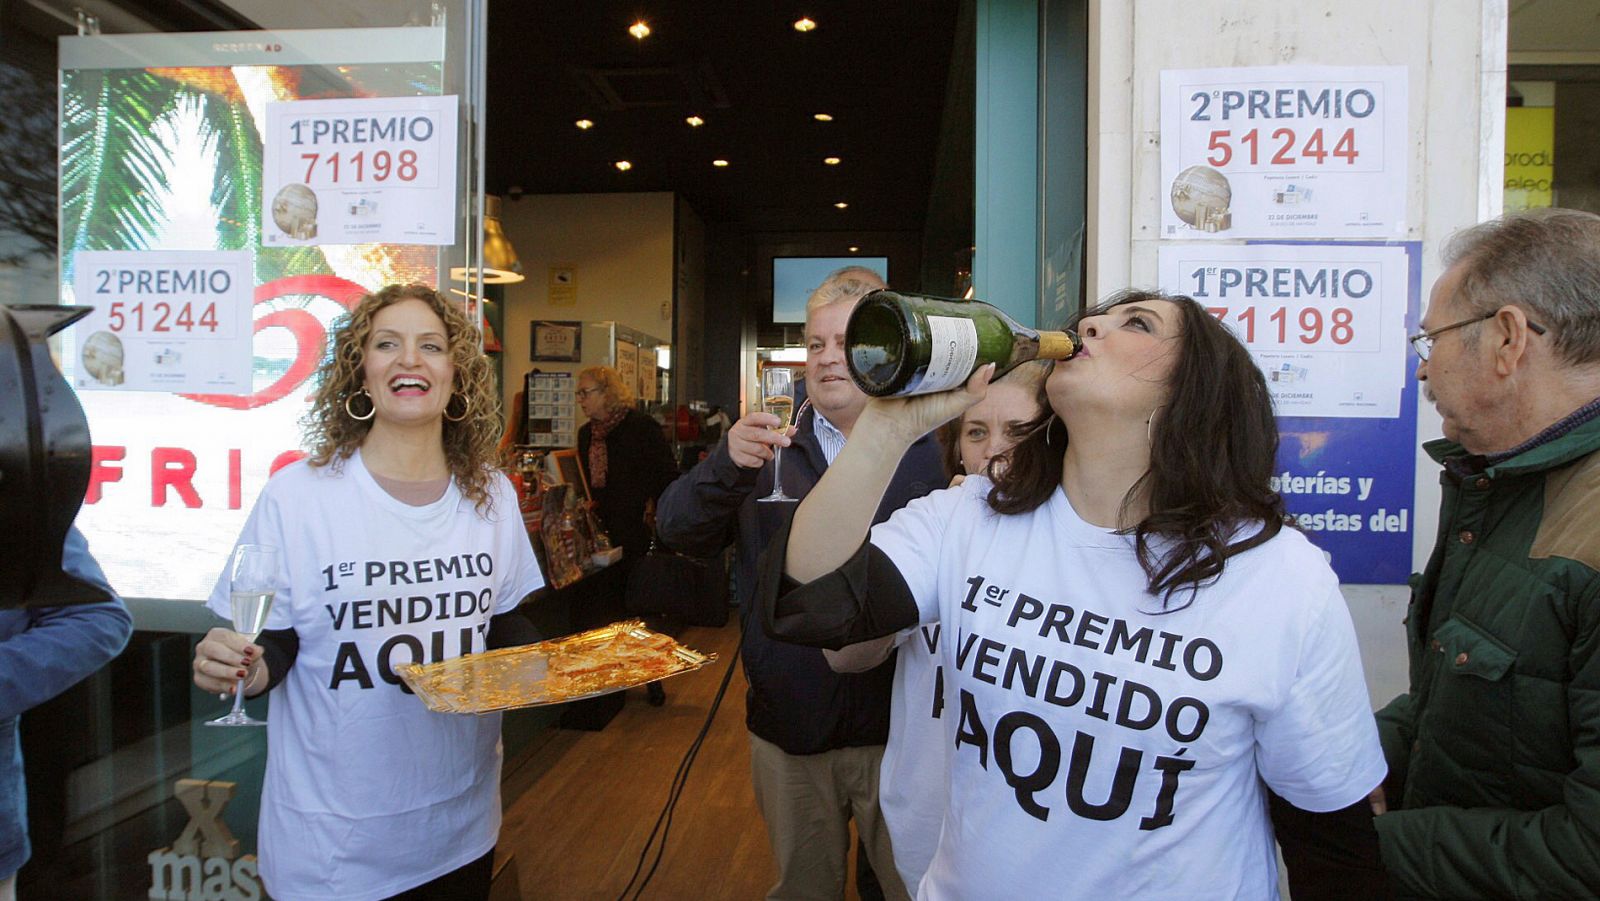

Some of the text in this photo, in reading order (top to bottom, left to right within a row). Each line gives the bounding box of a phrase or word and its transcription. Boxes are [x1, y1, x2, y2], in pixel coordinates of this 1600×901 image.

[1222, 88, 1376, 120] PREMIO
[312, 116, 434, 145] PREMIO
[1207, 127, 1359, 167] 51244
[301, 149, 418, 184] 71198
[119, 269, 231, 294] PREMIO
[1219, 268, 1373, 298] PREMIO
[108, 301, 219, 333] 51244
[84, 445, 309, 510] FRI
[1270, 470, 1374, 501] oterías y
[1284, 508, 1408, 532] estas del
[322, 552, 493, 592] 1er PREMIO
[325, 587, 492, 631] VENDIDO
[960, 574, 1010, 613] 1er
[1006, 592, 1224, 682] PREMIO
[955, 626, 1210, 743] VENDIDO
[955, 687, 1197, 832] AQUÍ
[174, 778, 240, 860] X
[147, 847, 261, 900] mas
